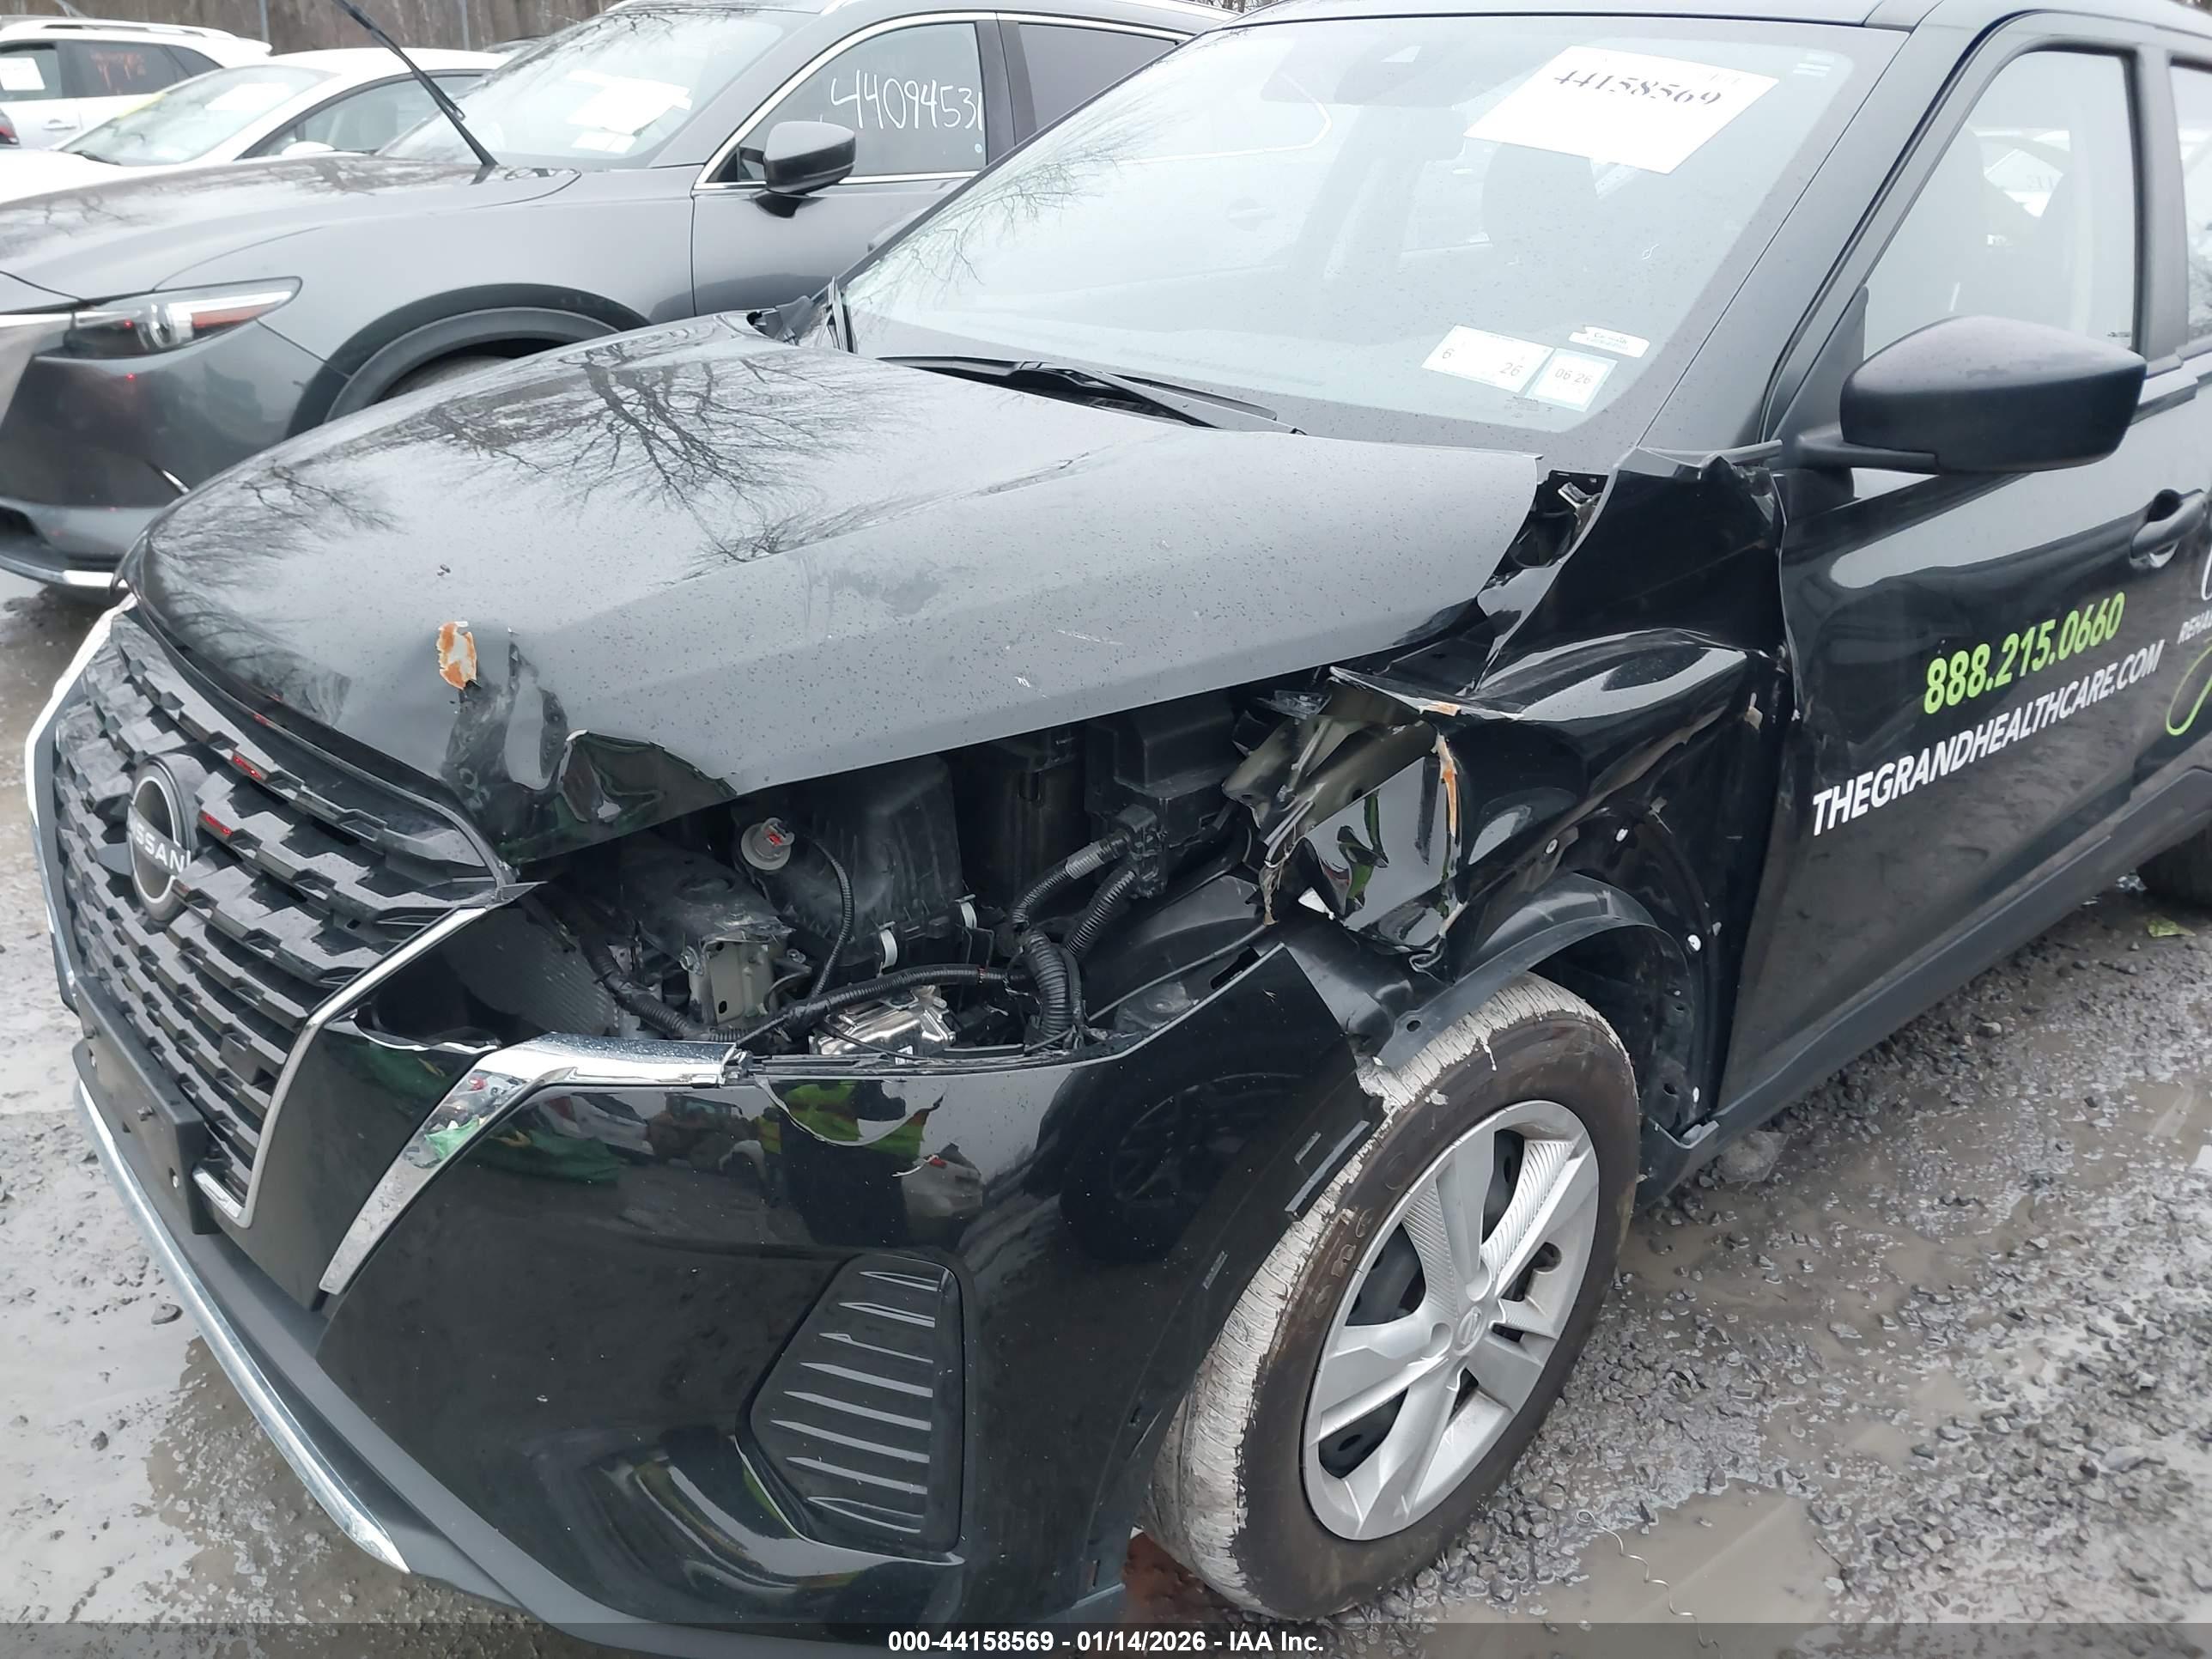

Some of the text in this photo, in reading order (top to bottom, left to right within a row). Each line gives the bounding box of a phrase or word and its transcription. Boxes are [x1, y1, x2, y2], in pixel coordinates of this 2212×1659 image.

[830, 69, 983, 131] 44094531
[1553, 70, 1722, 105] 44158569
[1442, 347, 1455, 360] 6
[1499, 362, 1523, 378] 26
[1554, 368, 1572, 381] 06
[1923, 592, 2126, 714] 888.215.0660
[1812, 639, 2166, 836] THEGRANDHEALTHCARE.COM
